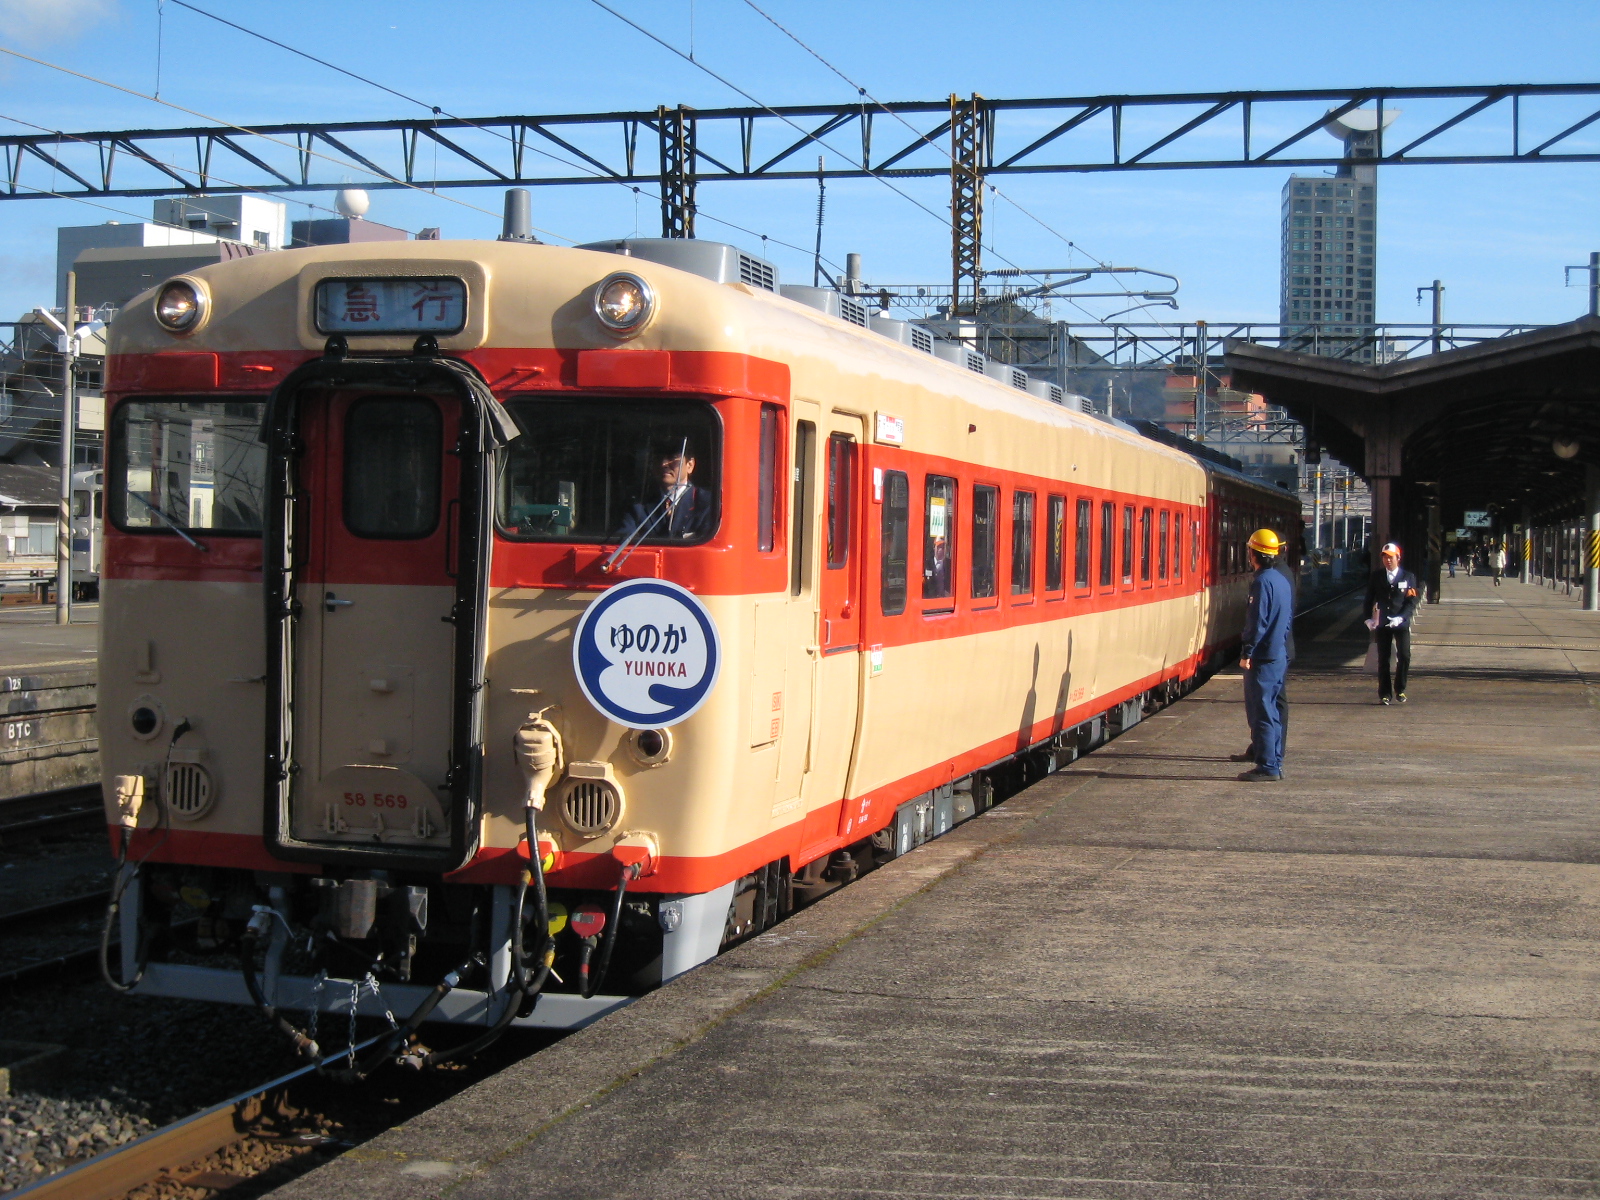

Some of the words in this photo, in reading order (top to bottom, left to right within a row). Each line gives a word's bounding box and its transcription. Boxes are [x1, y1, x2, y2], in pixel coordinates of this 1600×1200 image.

[341, 285, 453, 322] 急行
[610, 623, 688, 655] ゆのか
[624, 660, 688, 678] YUNOKA
[8, 722, 31, 739] BTC
[343, 792, 366, 807] 58
[373, 793, 408, 809] 569
